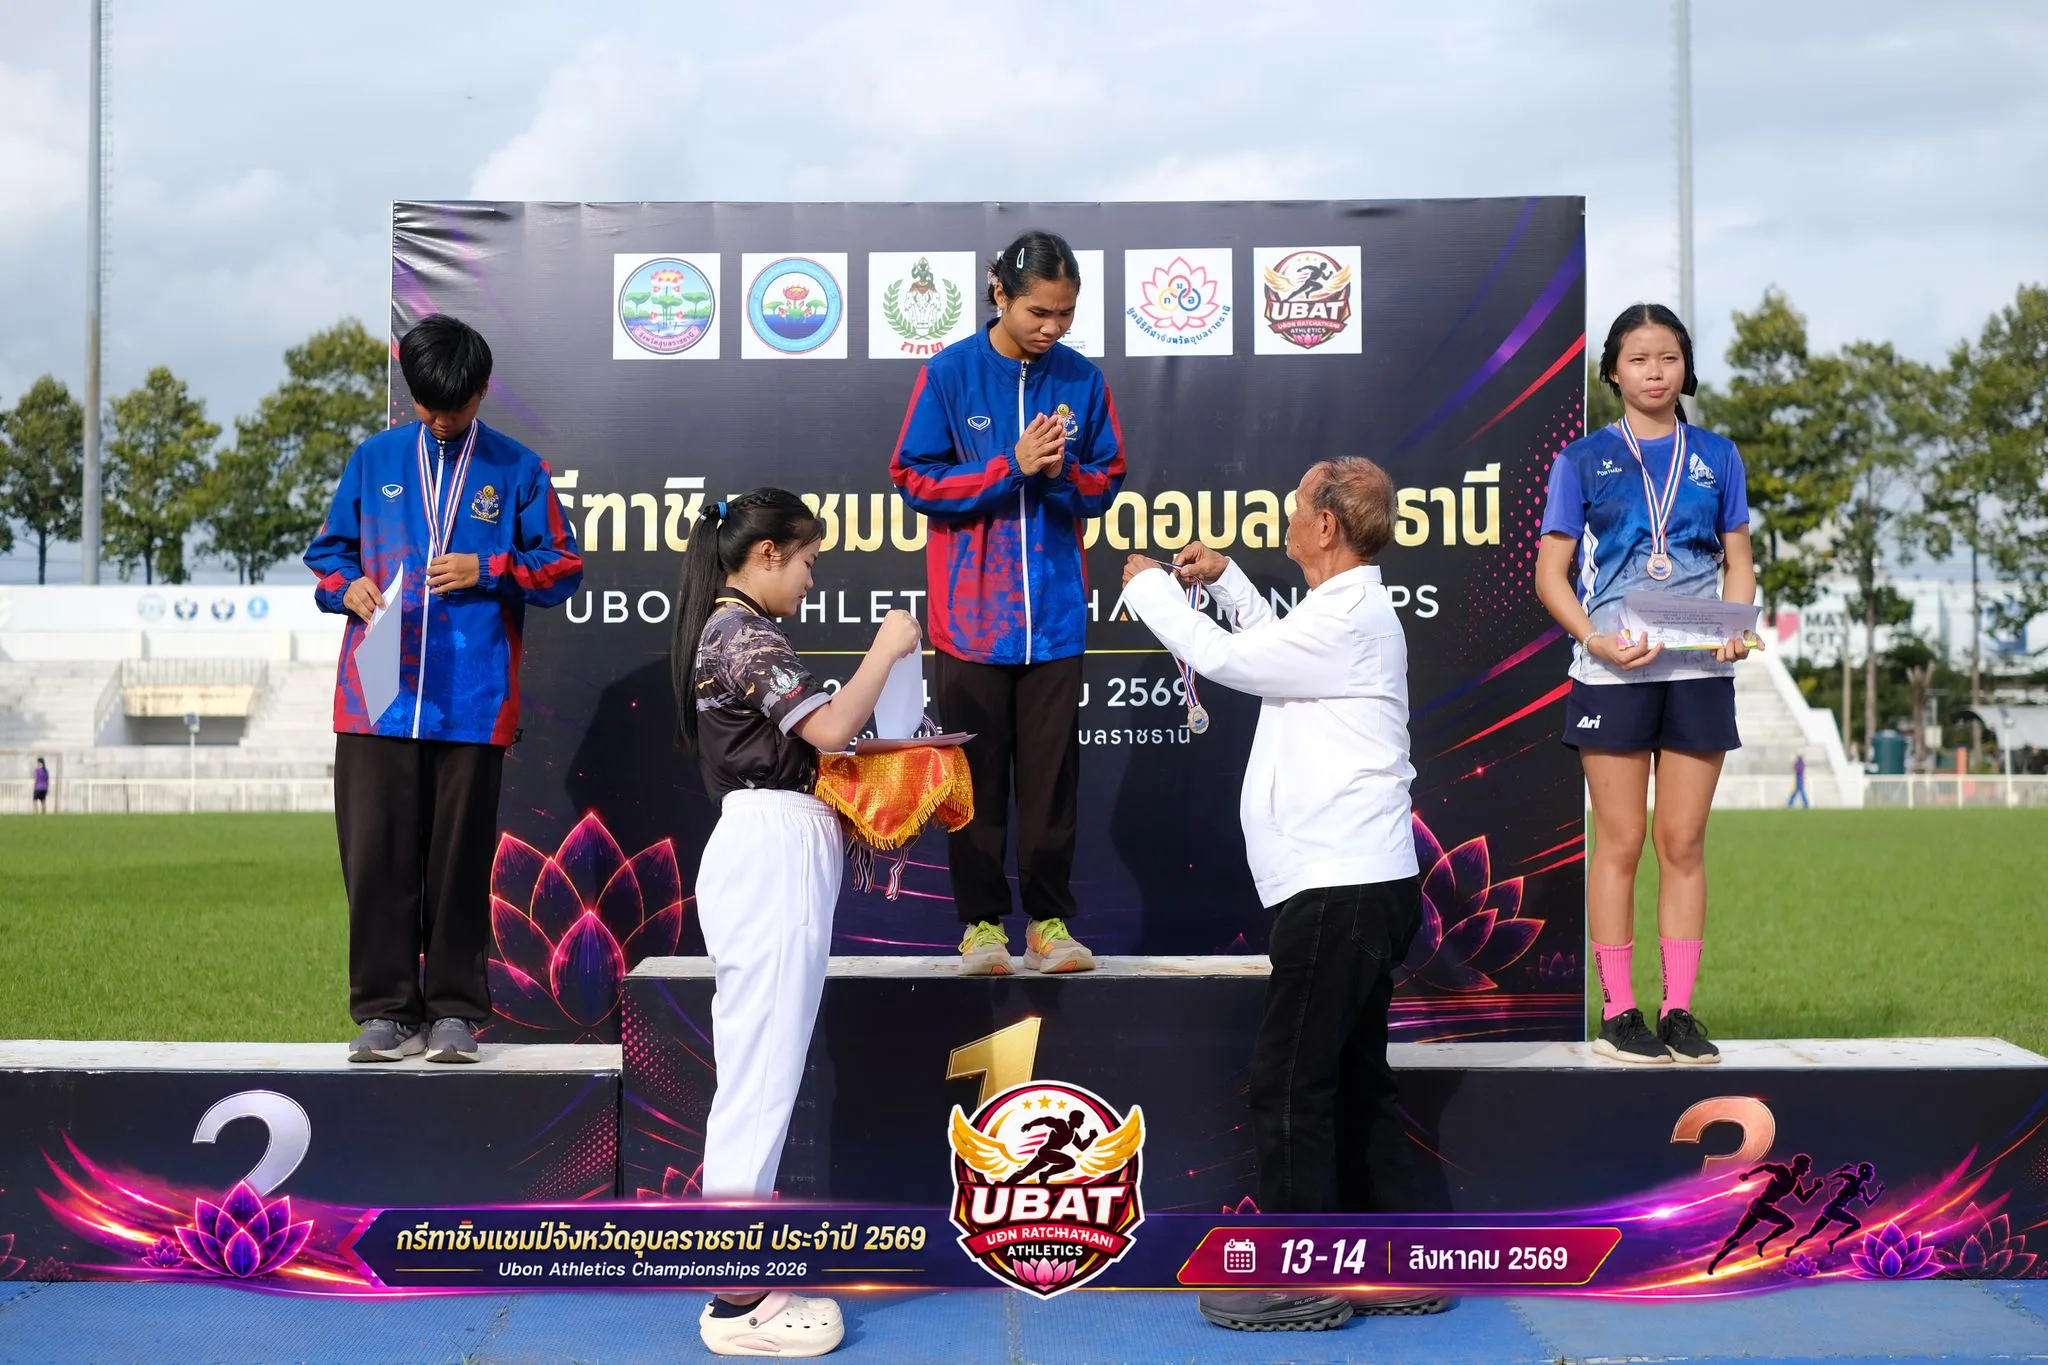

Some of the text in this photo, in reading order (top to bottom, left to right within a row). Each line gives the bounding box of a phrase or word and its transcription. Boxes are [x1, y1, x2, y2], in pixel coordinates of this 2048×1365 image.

[1271, 301, 1344, 320] UBAT
[566, 590, 682, 624] UBO
[1107, 677, 1188, 707] 2569
[1576, 714, 1602, 729] Ari
